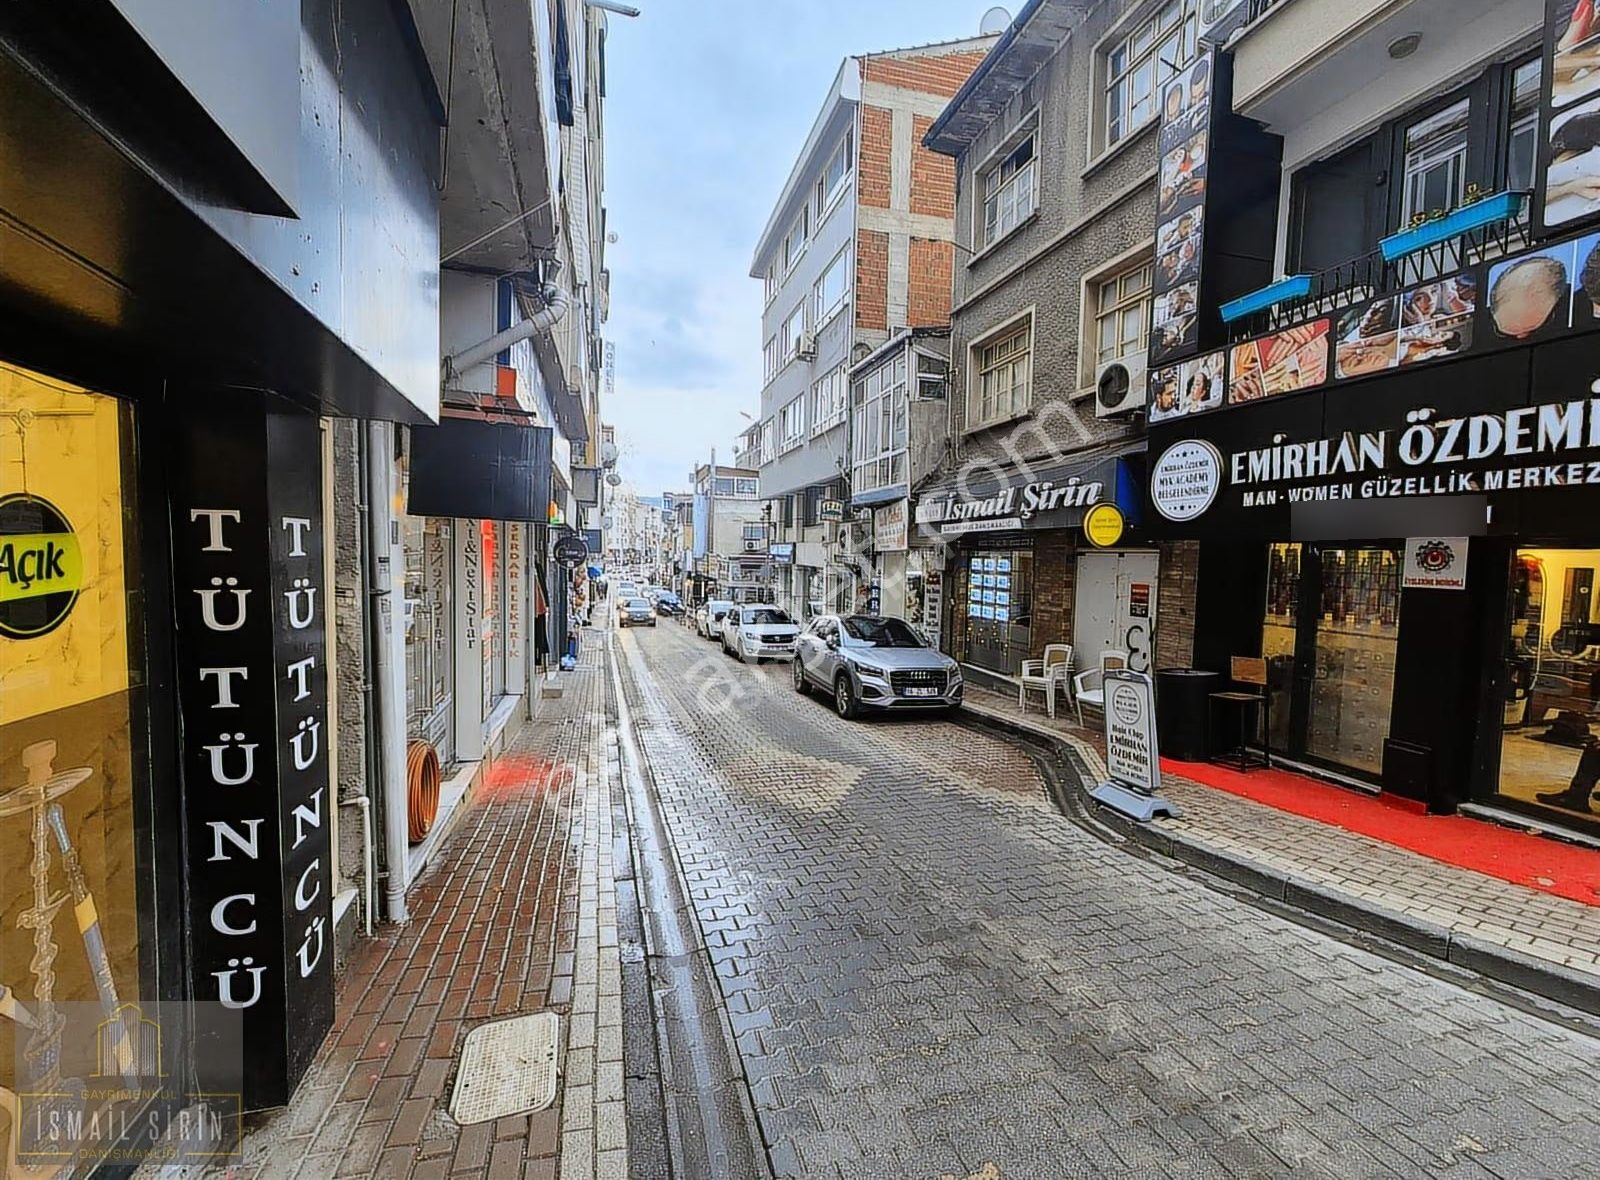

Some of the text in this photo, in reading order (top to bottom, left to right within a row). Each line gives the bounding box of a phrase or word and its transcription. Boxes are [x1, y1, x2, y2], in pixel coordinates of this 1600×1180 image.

[1230, 432, 1386, 485] EMİRHAN
[1360, 469, 1475, 499] GÜZELLİK
[943, 477, 1105, 521] İsmail Şirin
[0, 541, 65, 590] Açık
[508, 523, 520, 579] SERDAR
[190, 508, 268, 1010] TÜTÜNCÜ
[281, 516, 326, 979] TÜTÜNCÜ
